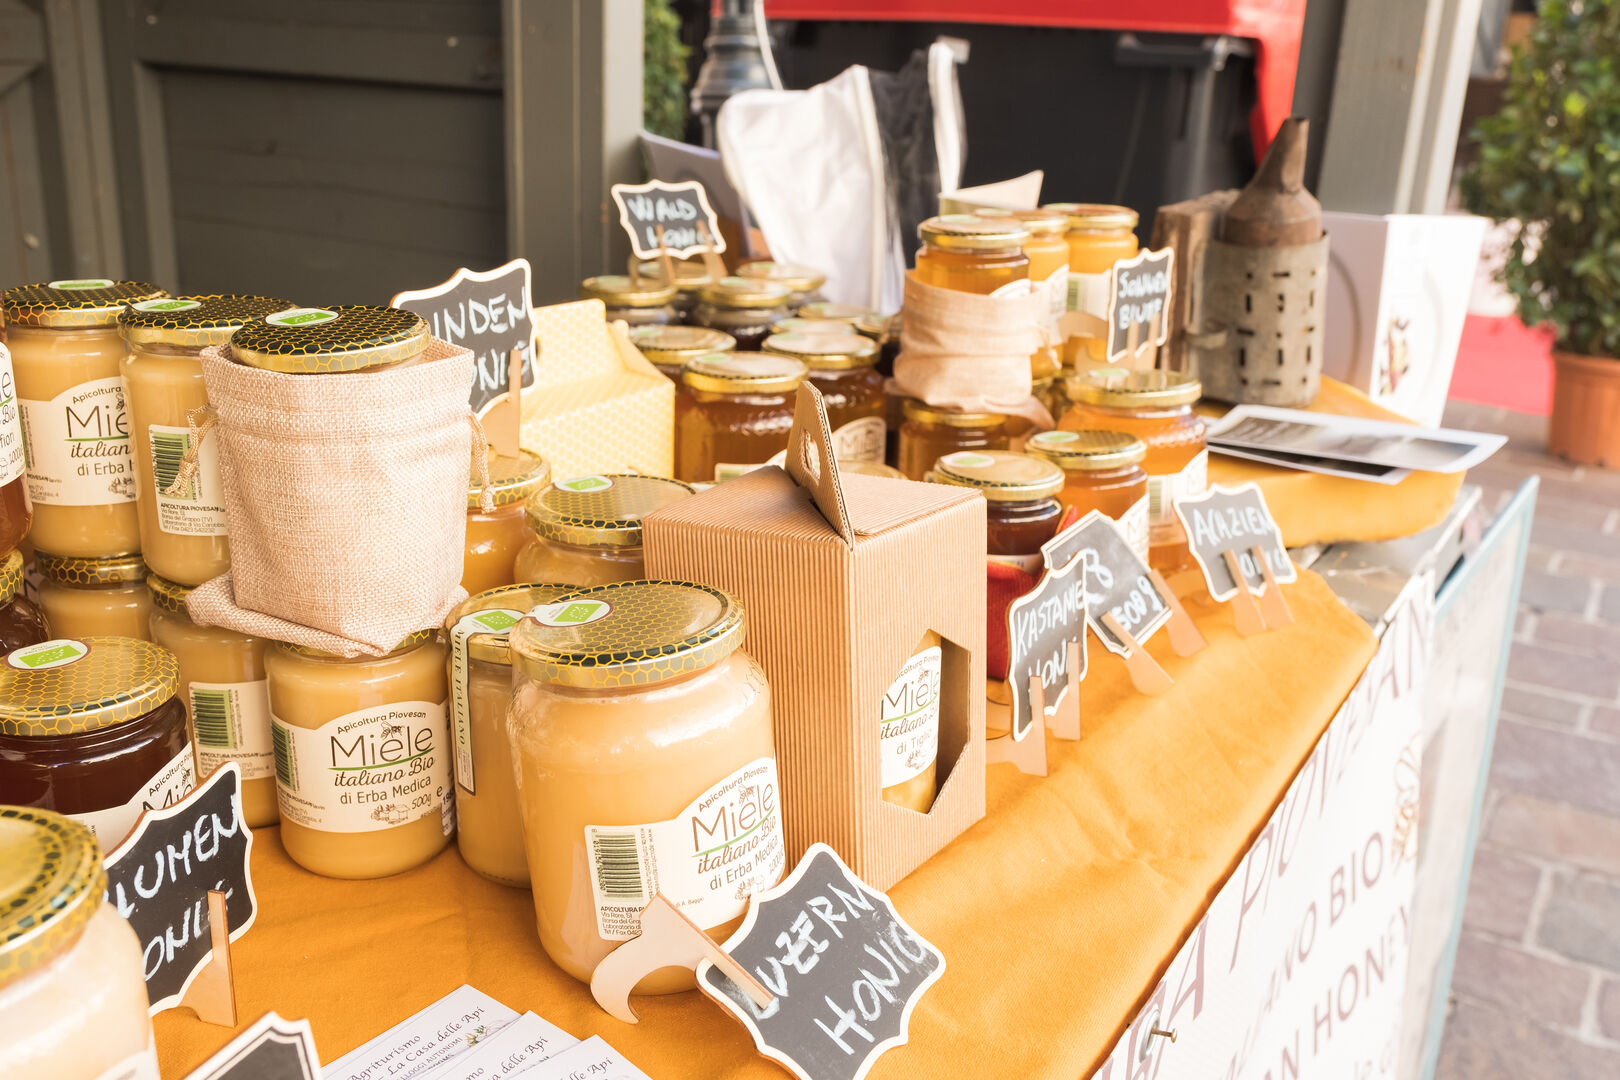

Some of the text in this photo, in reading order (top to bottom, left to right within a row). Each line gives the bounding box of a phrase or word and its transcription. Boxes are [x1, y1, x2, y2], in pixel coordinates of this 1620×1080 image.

[433, 286, 527, 344] INDEN
[72, 386, 122, 405] Apicoltura
[66, 405, 129, 438] Mie
[70, 441, 130, 458] italian
[77, 462, 125, 476] di Erba
[454, 630, 465, 678] MIELE
[337, 711, 427, 735] Apicoltura Piovesan
[331, 726, 433, 767] Miele
[897, 743, 907, 756] di
[149, 760, 184, 797] Apicoltura
[334, 769, 406, 787] italiano
[408, 755, 434, 777] Bio
[340, 792, 351, 804] di
[357, 790, 387, 804] Erba
[392, 775, 431, 798] Medica
[411, 794, 432, 810] 500g
[698, 775, 743, 813] Apicoltura
[691, 783, 774, 853] Miele
[103, 794, 238, 919] LUMEN
[697, 816, 776, 875] italiano Bio
[709, 835, 779, 891] di Erba Medica
[1330, 831, 1384, 928] BIO
[813, 920, 927, 1056] HONIG
[386, 1062, 406, 1076] La
[405, 1040, 436, 1062] Casa
[437, 1021, 462, 1042] delle
[461, 1006, 485, 1023] Api
[426, 1037, 464, 1064] AUTONOMI
[501, 1052, 527, 1075] delle
[524, 1036, 548, 1055] Api
[586, 1056, 613, 1075] Api
